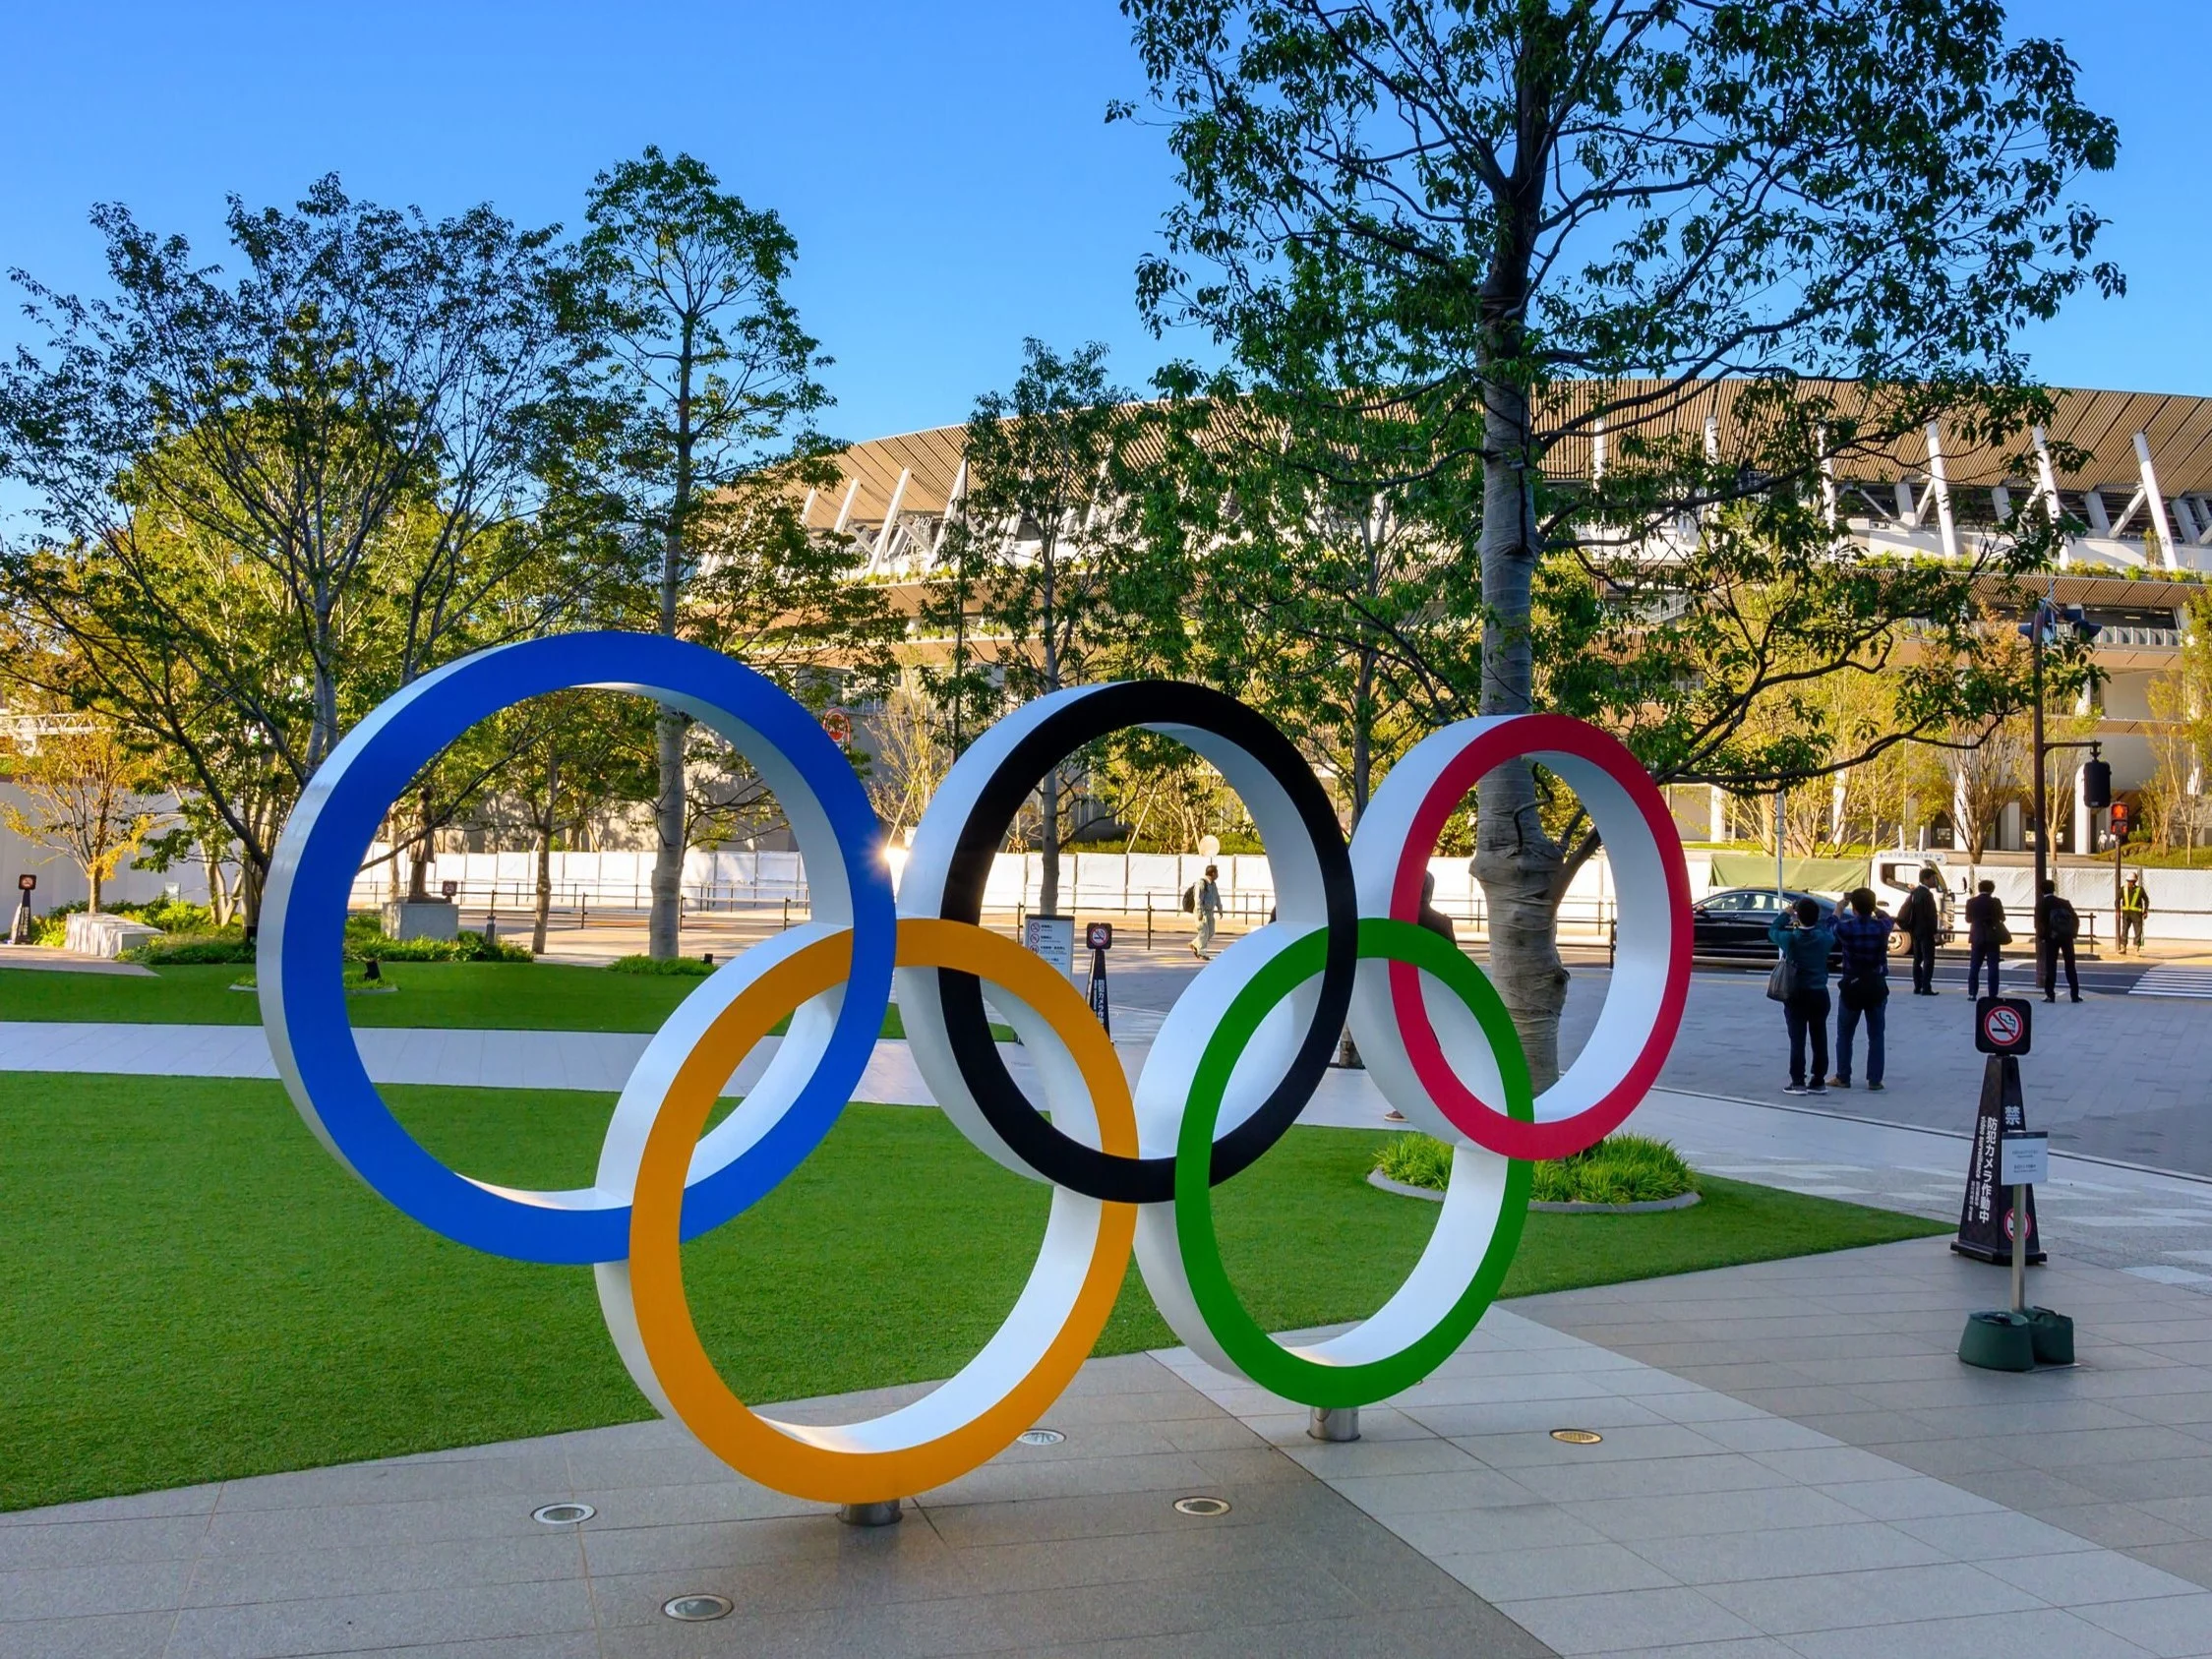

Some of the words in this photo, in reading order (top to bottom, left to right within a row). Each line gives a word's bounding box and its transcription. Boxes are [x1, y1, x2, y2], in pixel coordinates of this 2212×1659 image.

[1979, 1116, 1998, 1223] 防犯カメラ作動中
